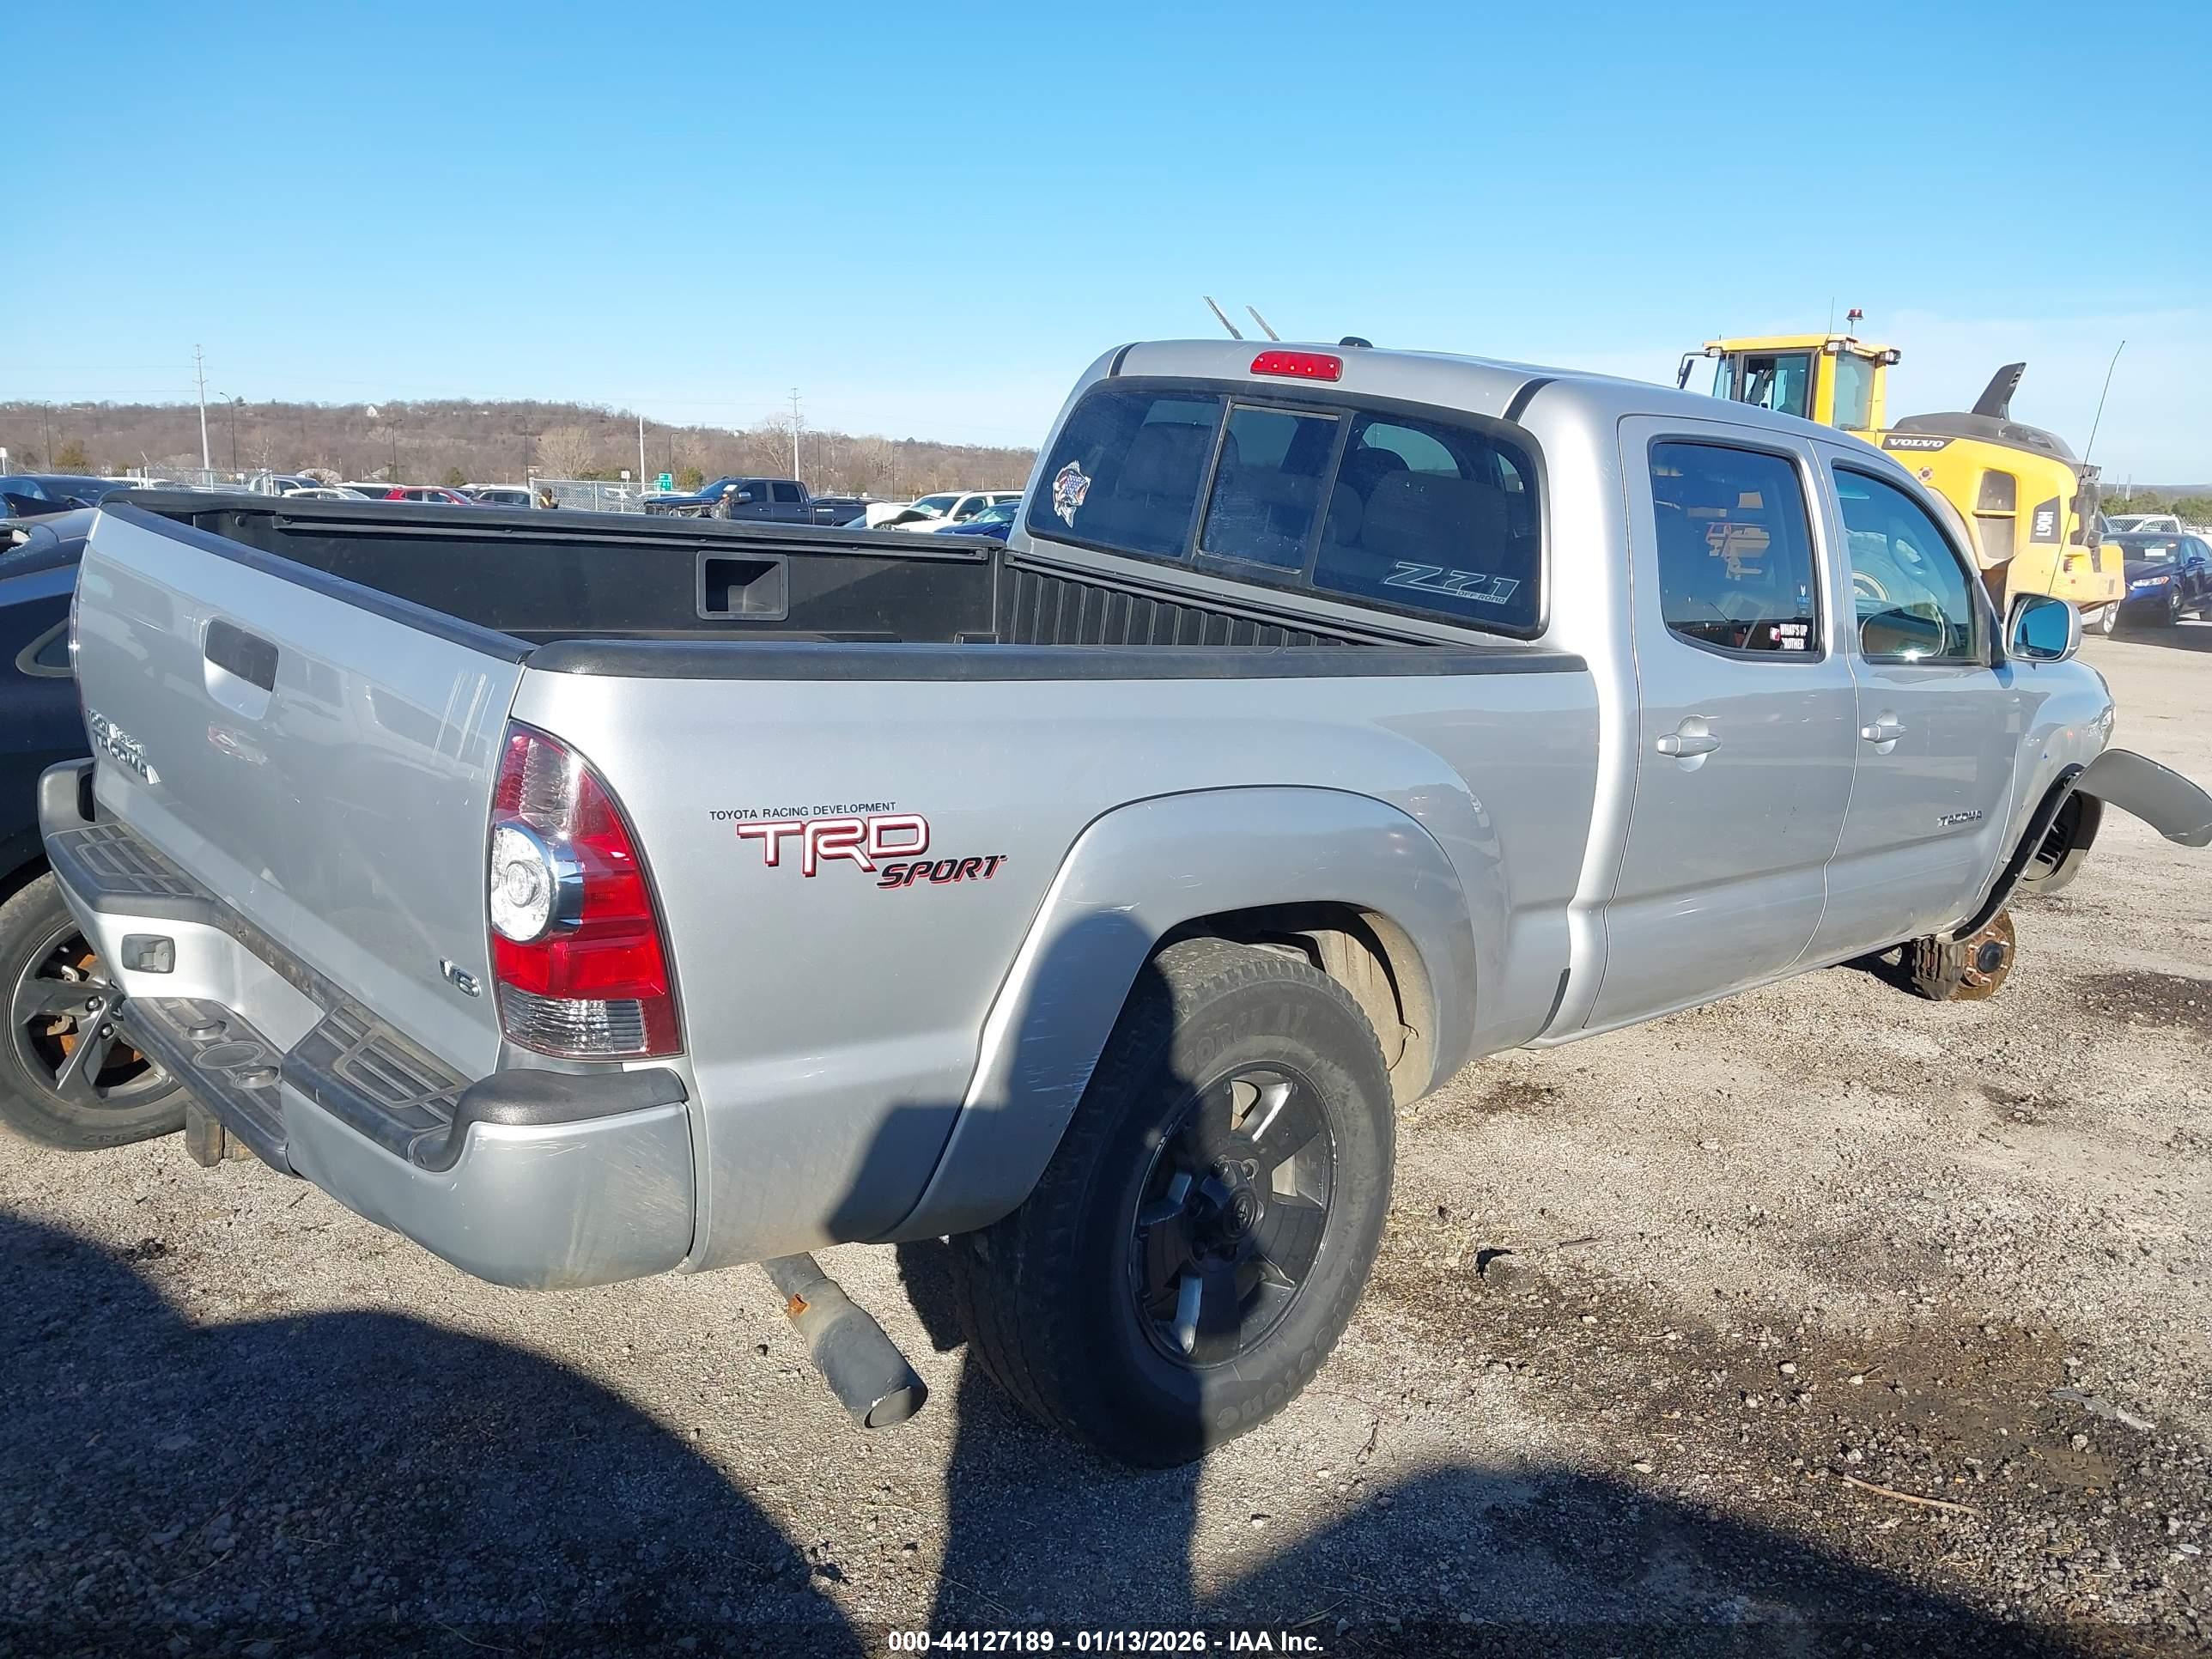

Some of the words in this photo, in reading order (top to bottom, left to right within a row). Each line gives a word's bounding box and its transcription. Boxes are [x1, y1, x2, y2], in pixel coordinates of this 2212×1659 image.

[1889, 438, 1945, 447] VOLVO
[2035, 511, 2054, 537] L90H
[1383, 561, 1521, 603] Z71
[1801, 624, 1808, 636] UP
[709, 810, 758, 821] TOYOTA
[763, 806, 809, 817] RACING
[813, 801, 896, 815] DEVELOPMENT
[1937, 810, 1983, 827] TACOMA
[736, 813, 930, 878] TRD
[876, 854, 1008, 890] SPORT
[439, 957, 481, 998] V6
